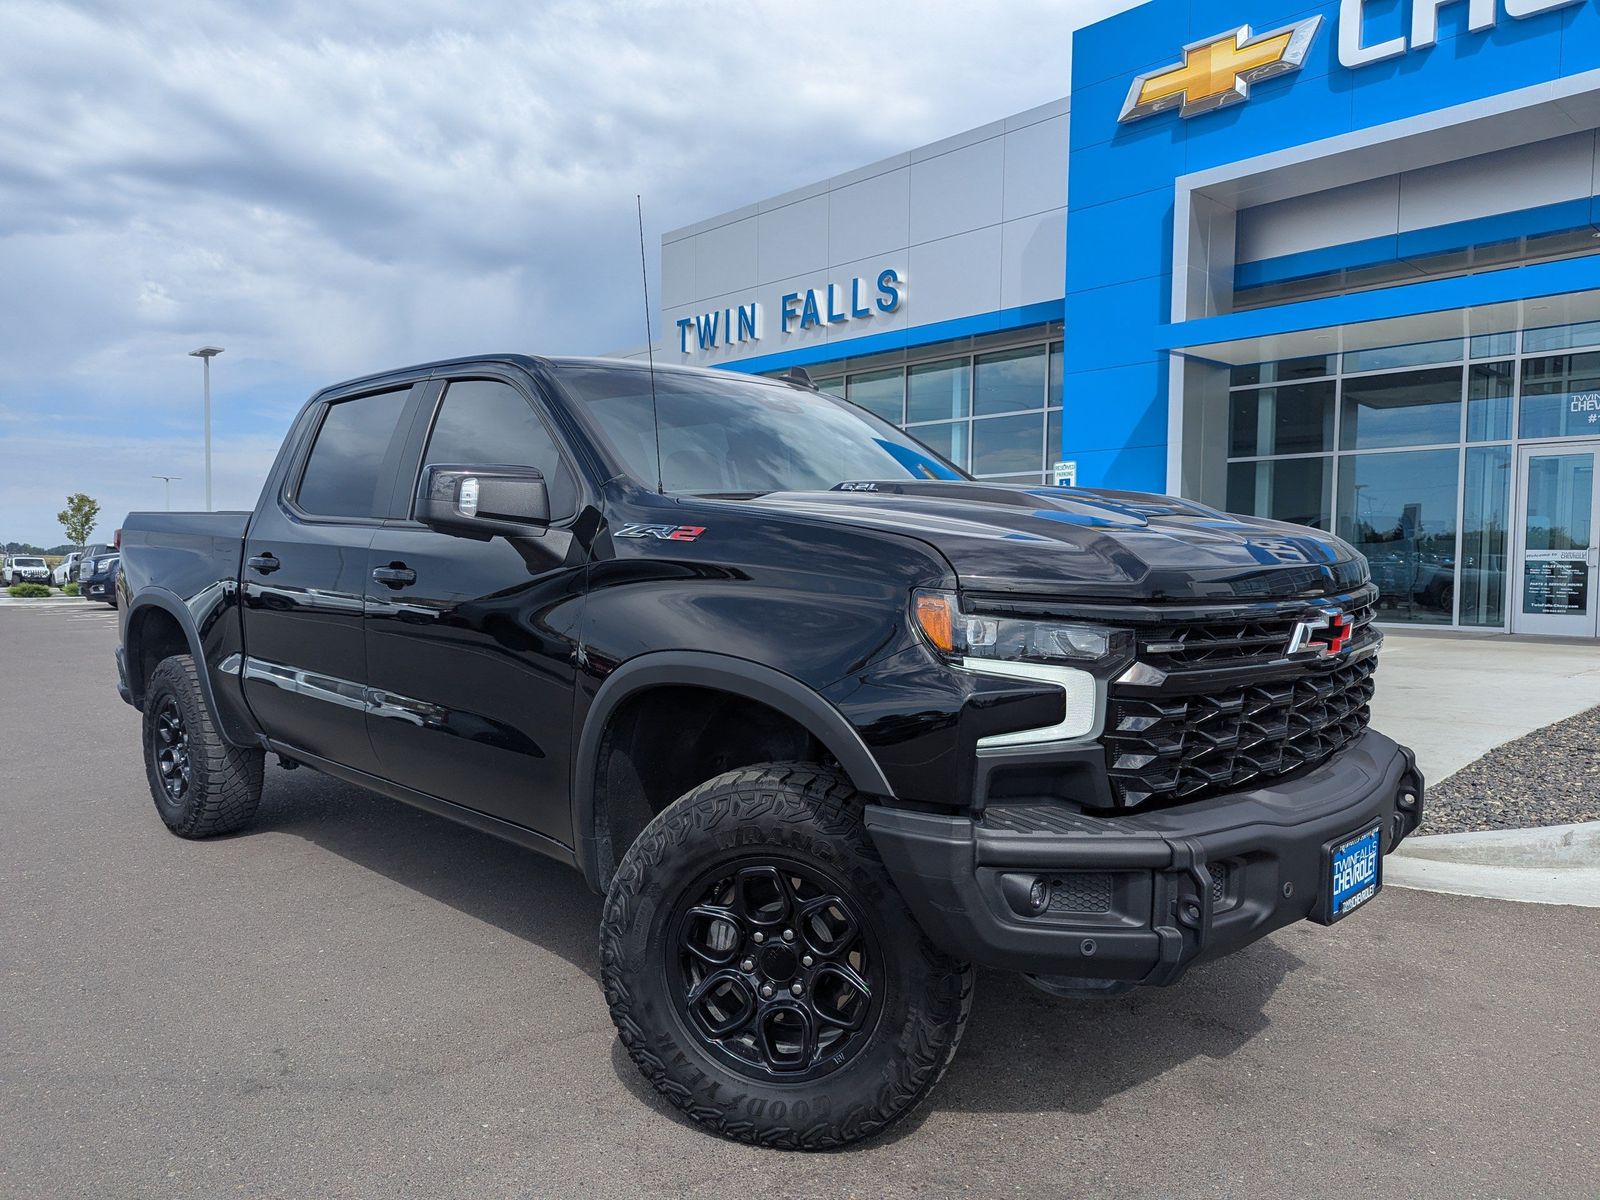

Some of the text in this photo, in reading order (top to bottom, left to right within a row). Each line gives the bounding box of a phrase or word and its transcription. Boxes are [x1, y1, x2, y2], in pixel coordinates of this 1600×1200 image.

[677, 269, 905, 353] TWIN FALLS
[613, 523, 708, 542] ZR2
[1333, 853, 1377, 896] CHEVROLET
